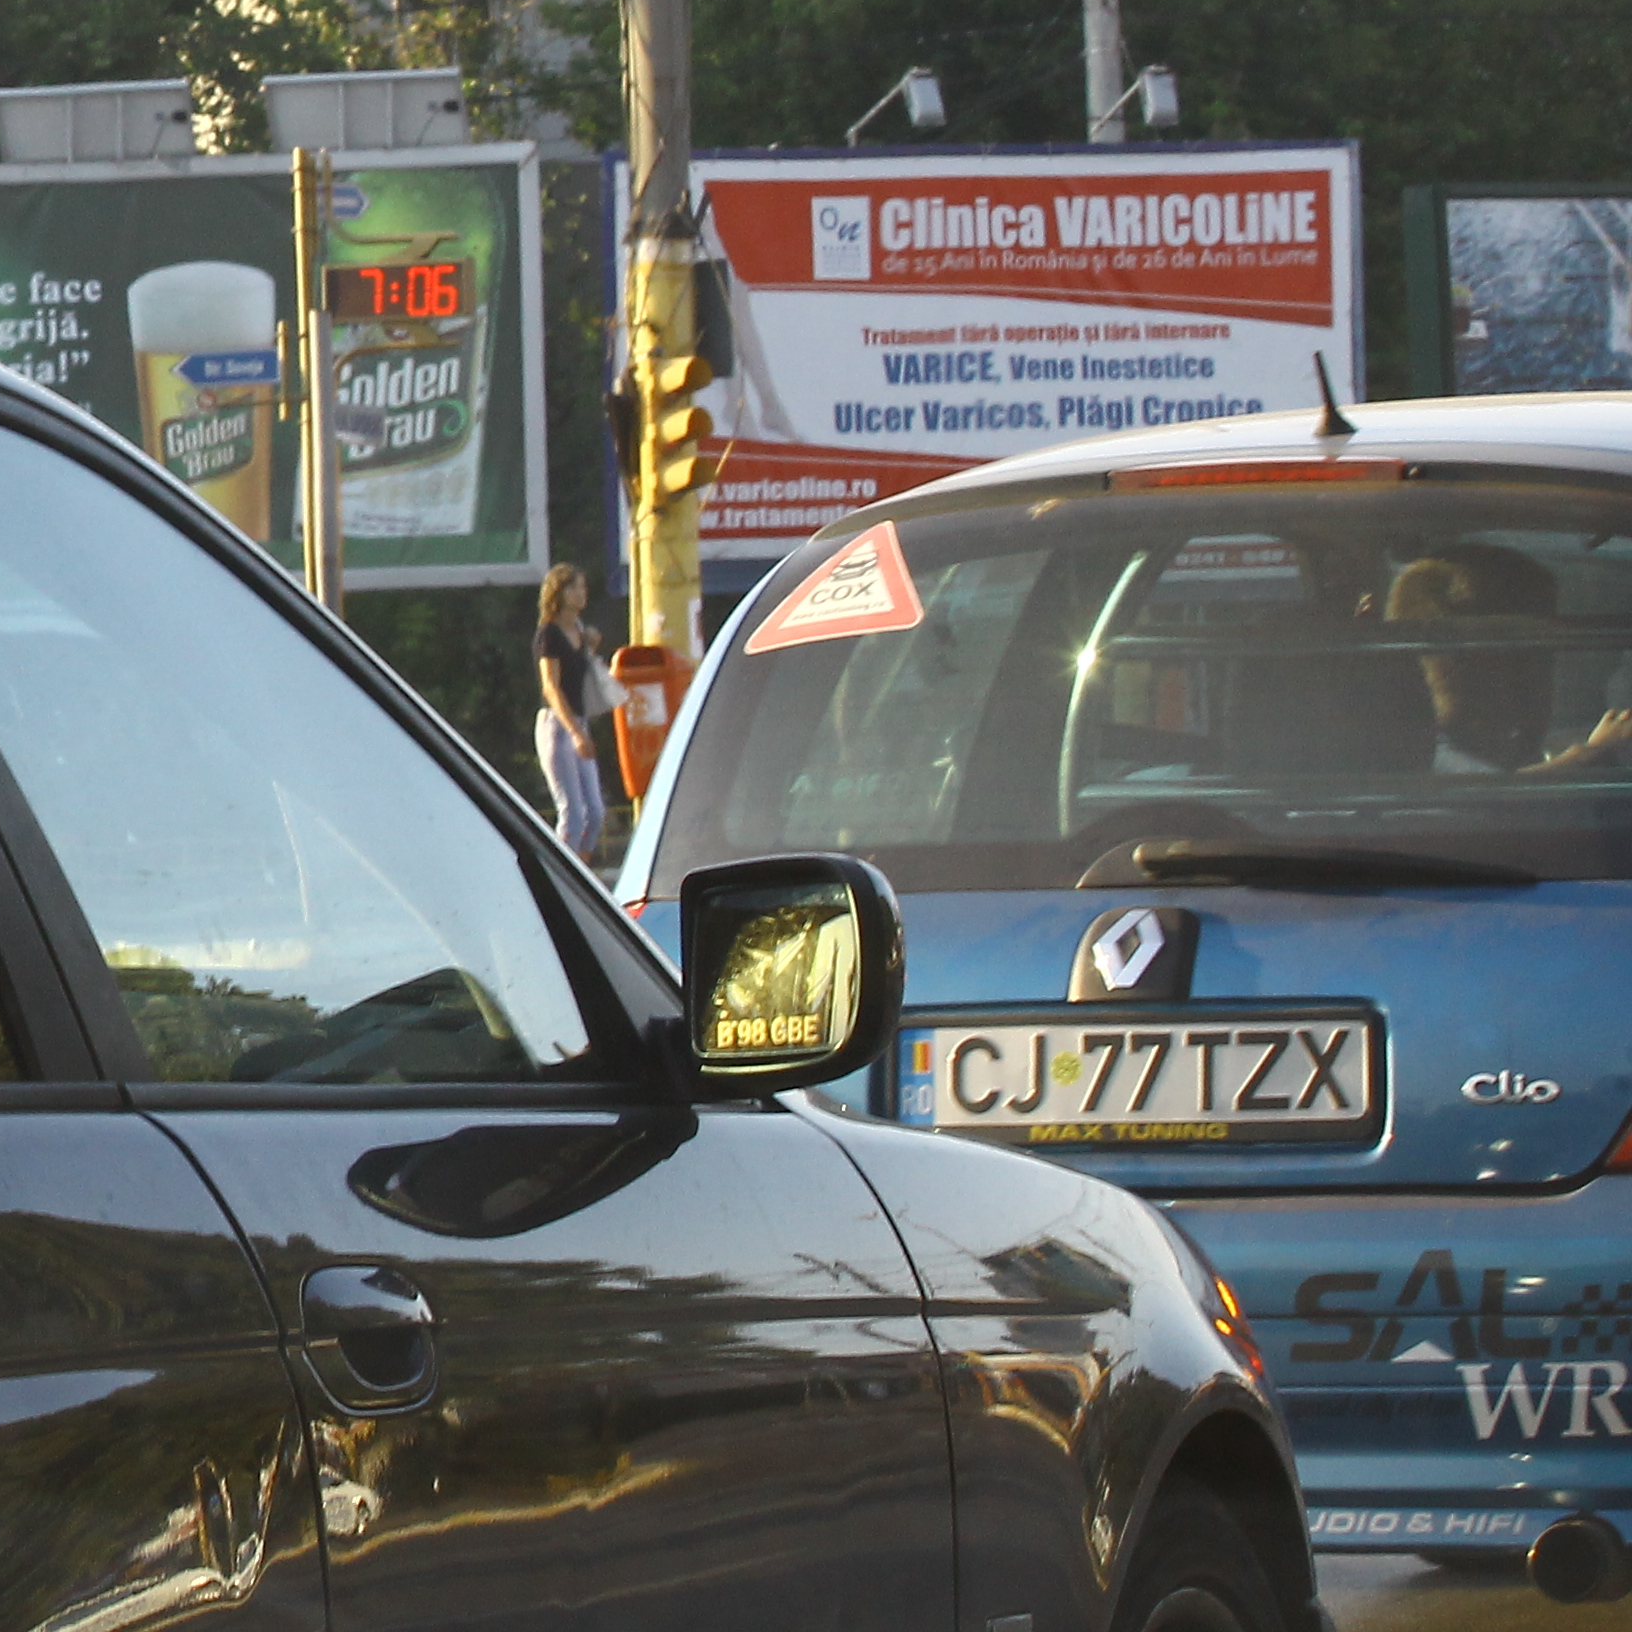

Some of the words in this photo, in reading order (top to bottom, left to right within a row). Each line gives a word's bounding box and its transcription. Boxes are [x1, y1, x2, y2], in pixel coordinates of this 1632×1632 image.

[879, 196, 1046, 251] Clinica
[882, 252, 909, 274] de
[940, 251, 976, 271] Ani
[1002, 248, 1087, 271] România
[1112, 248, 1137, 269] de
[1170, 247, 1196, 268] de
[1199, 246, 1234, 268] Ani
[1260, 246, 1319, 267] Lume
[29, 271, 102, 304] face
[359, 265, 459, 317] 7:06
[862, 327, 956, 346] Tratament
[1145, 323, 1231, 341] internare
[883, 350, 1002, 386] VARICE,
[1009, 352, 1074, 381] Vene
[1081, 353, 1216, 380] Inestetice
[834, 402, 916, 434] Ulcer
[922, 397, 1052, 433] Varicos,
[1058, 394, 1135, 431] Plăgi
[165, 412, 248, 459] Golden
[809, 578, 879, 606] COX
[737, 1017, 768, 1047] 98
[770, 1013, 822, 1046] GBE
[946, 1032, 1048, 1115] CJ
[1078, 1029, 1173, 1114] 77
[1182, 1028, 1351, 1112] TZX
[1459, 1069, 1562, 1106] Clio
[1028, 1123, 1103, 1143] MAX
[1114, 1123, 1231, 1142] TUNING
[1444, 1512, 1526, 1535] HIFI
